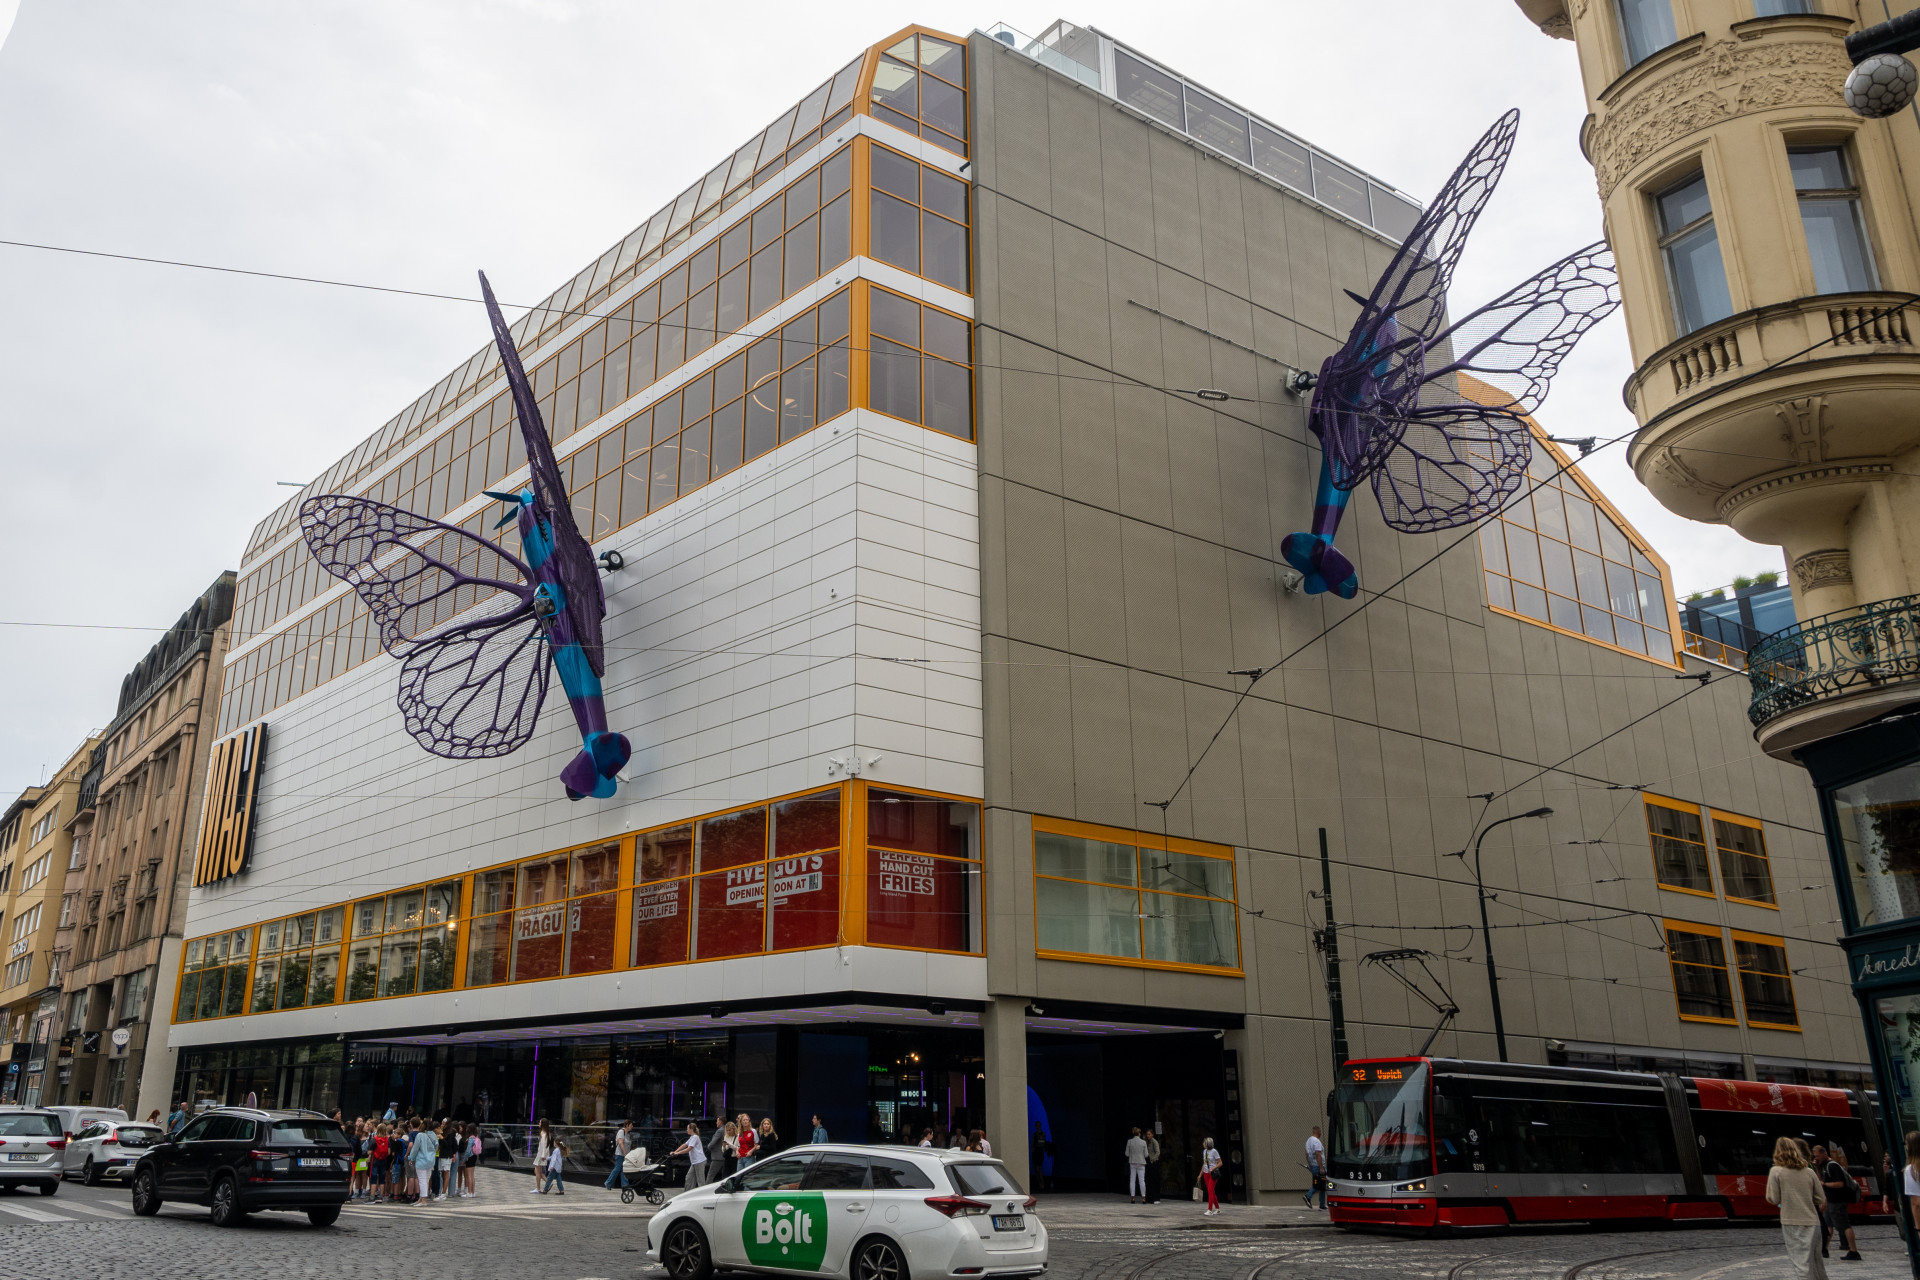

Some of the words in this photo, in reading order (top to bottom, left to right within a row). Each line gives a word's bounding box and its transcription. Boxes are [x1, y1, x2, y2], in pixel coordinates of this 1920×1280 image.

[727, 866, 764, 886] FIVE
[880, 861, 911, 874] HAND
[912, 865, 935, 877] CUT
[774, 880, 793, 894] OON
[795, 878, 807, 890] AT
[881, 874, 933, 894] FRIES
[639, 908, 655, 919] OUR
[656, 903, 678, 917] LIFE!
[1353, 1069, 1366, 1081] 32
[1376, 1069, 1403, 1080] Vypich
[756, 1209, 812, 1245] Bolt
